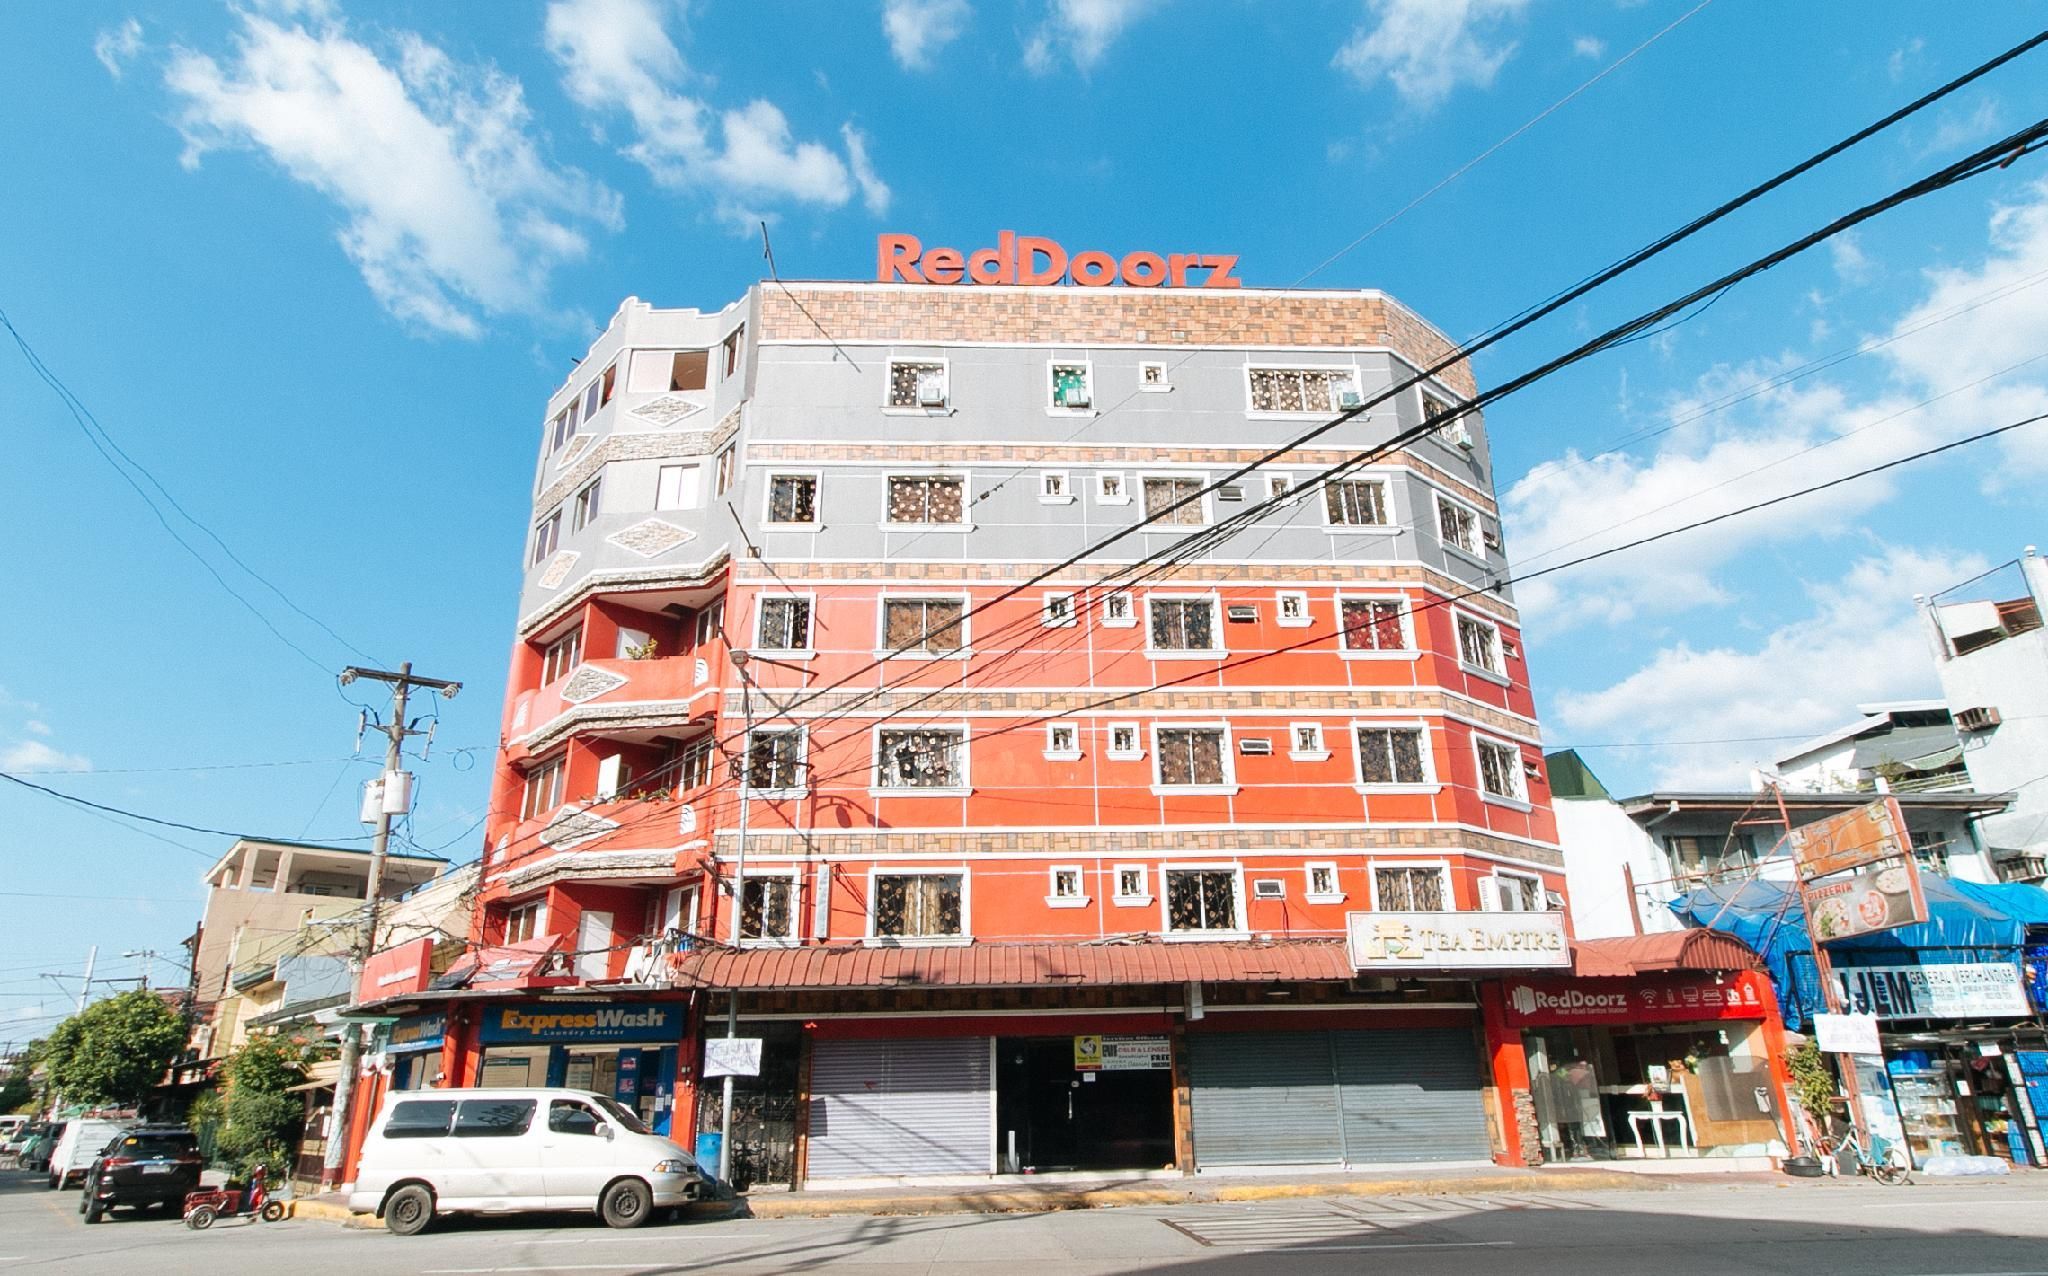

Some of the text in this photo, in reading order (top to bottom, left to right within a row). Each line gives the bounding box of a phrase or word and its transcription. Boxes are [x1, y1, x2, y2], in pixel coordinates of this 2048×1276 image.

[877, 230, 1241, 288] RedDoorz
[1807, 882, 1853, 901] PIZZERIA
[1419, 928, 1562, 951] TEA EMPIRE
[1535, 989, 1628, 1009] RedDoorz
[501, 1008, 665, 1035] ExpressWash
[543, 1028, 625, 1037] Laundry Center
